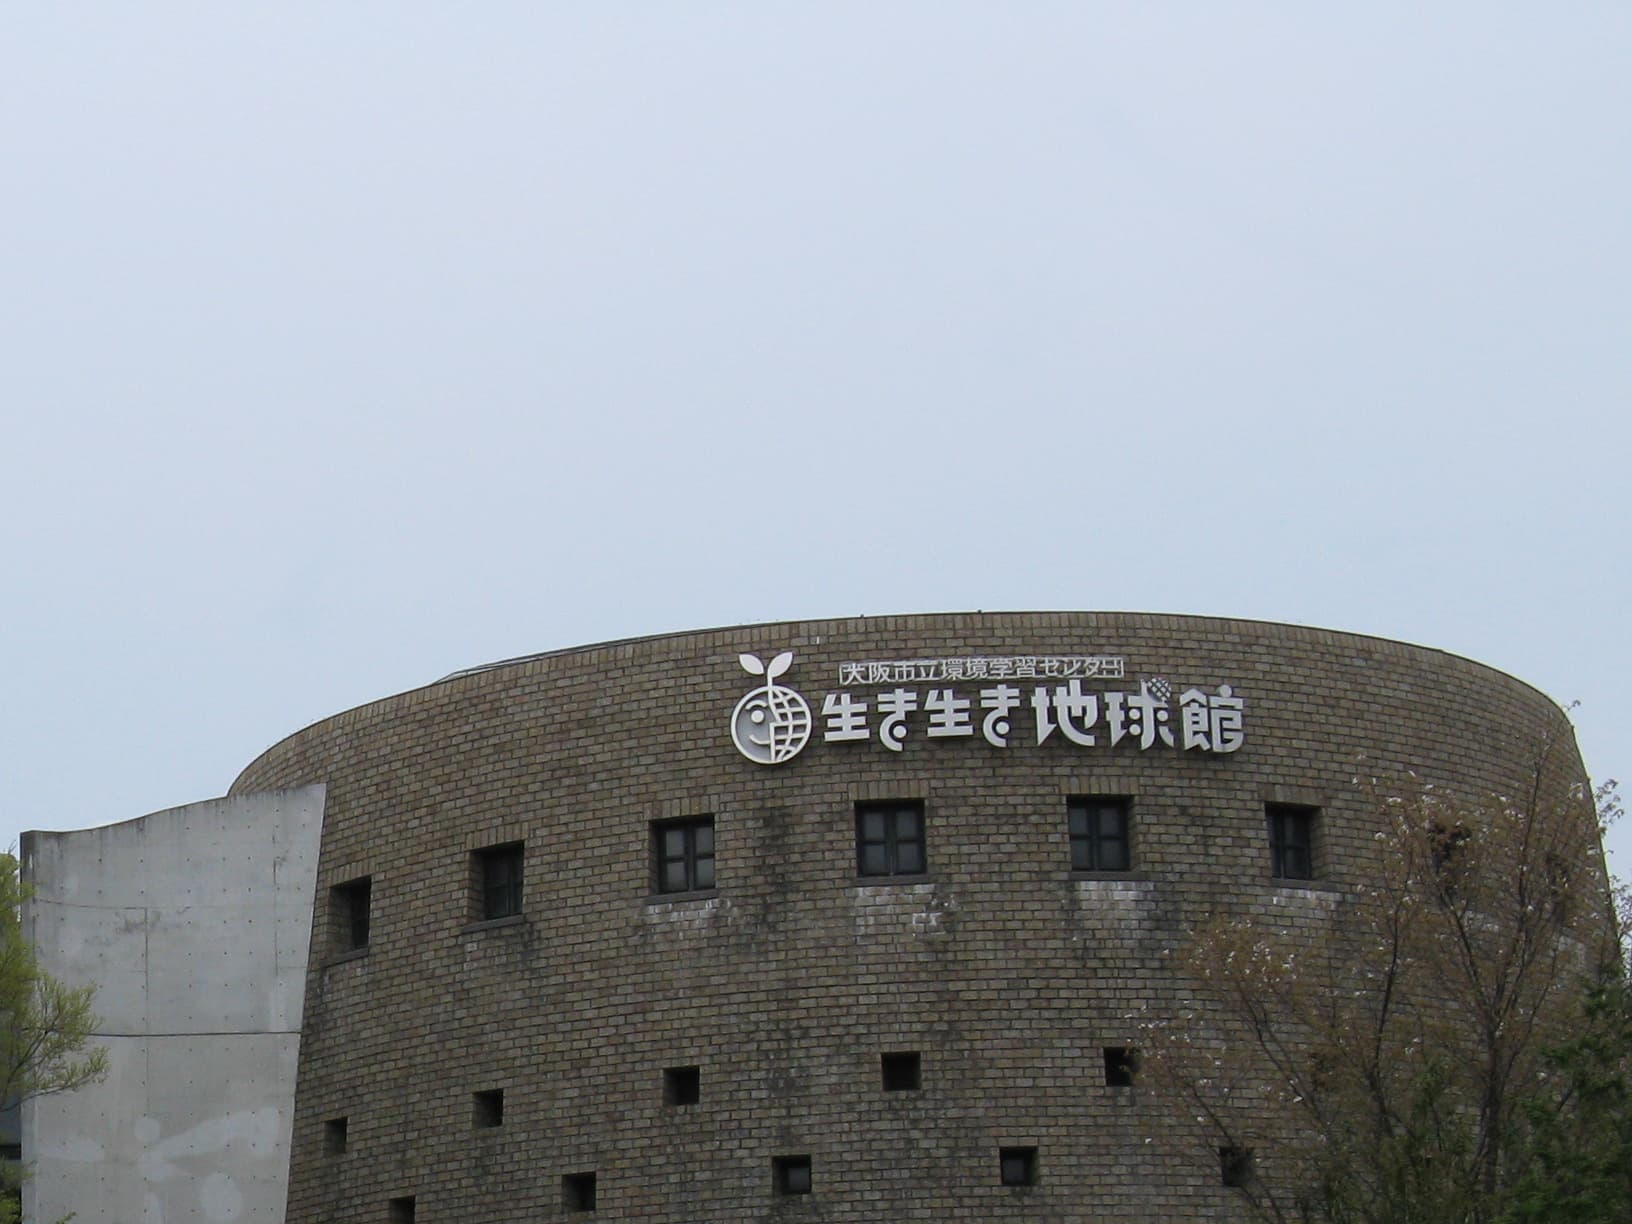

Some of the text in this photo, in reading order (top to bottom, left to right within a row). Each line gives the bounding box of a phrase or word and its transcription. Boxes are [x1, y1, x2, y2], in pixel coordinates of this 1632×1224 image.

[840, 656, 1124, 686] 大阪市立環境学習センター
[821, 677, 1245, 754] 生き生き地球館
